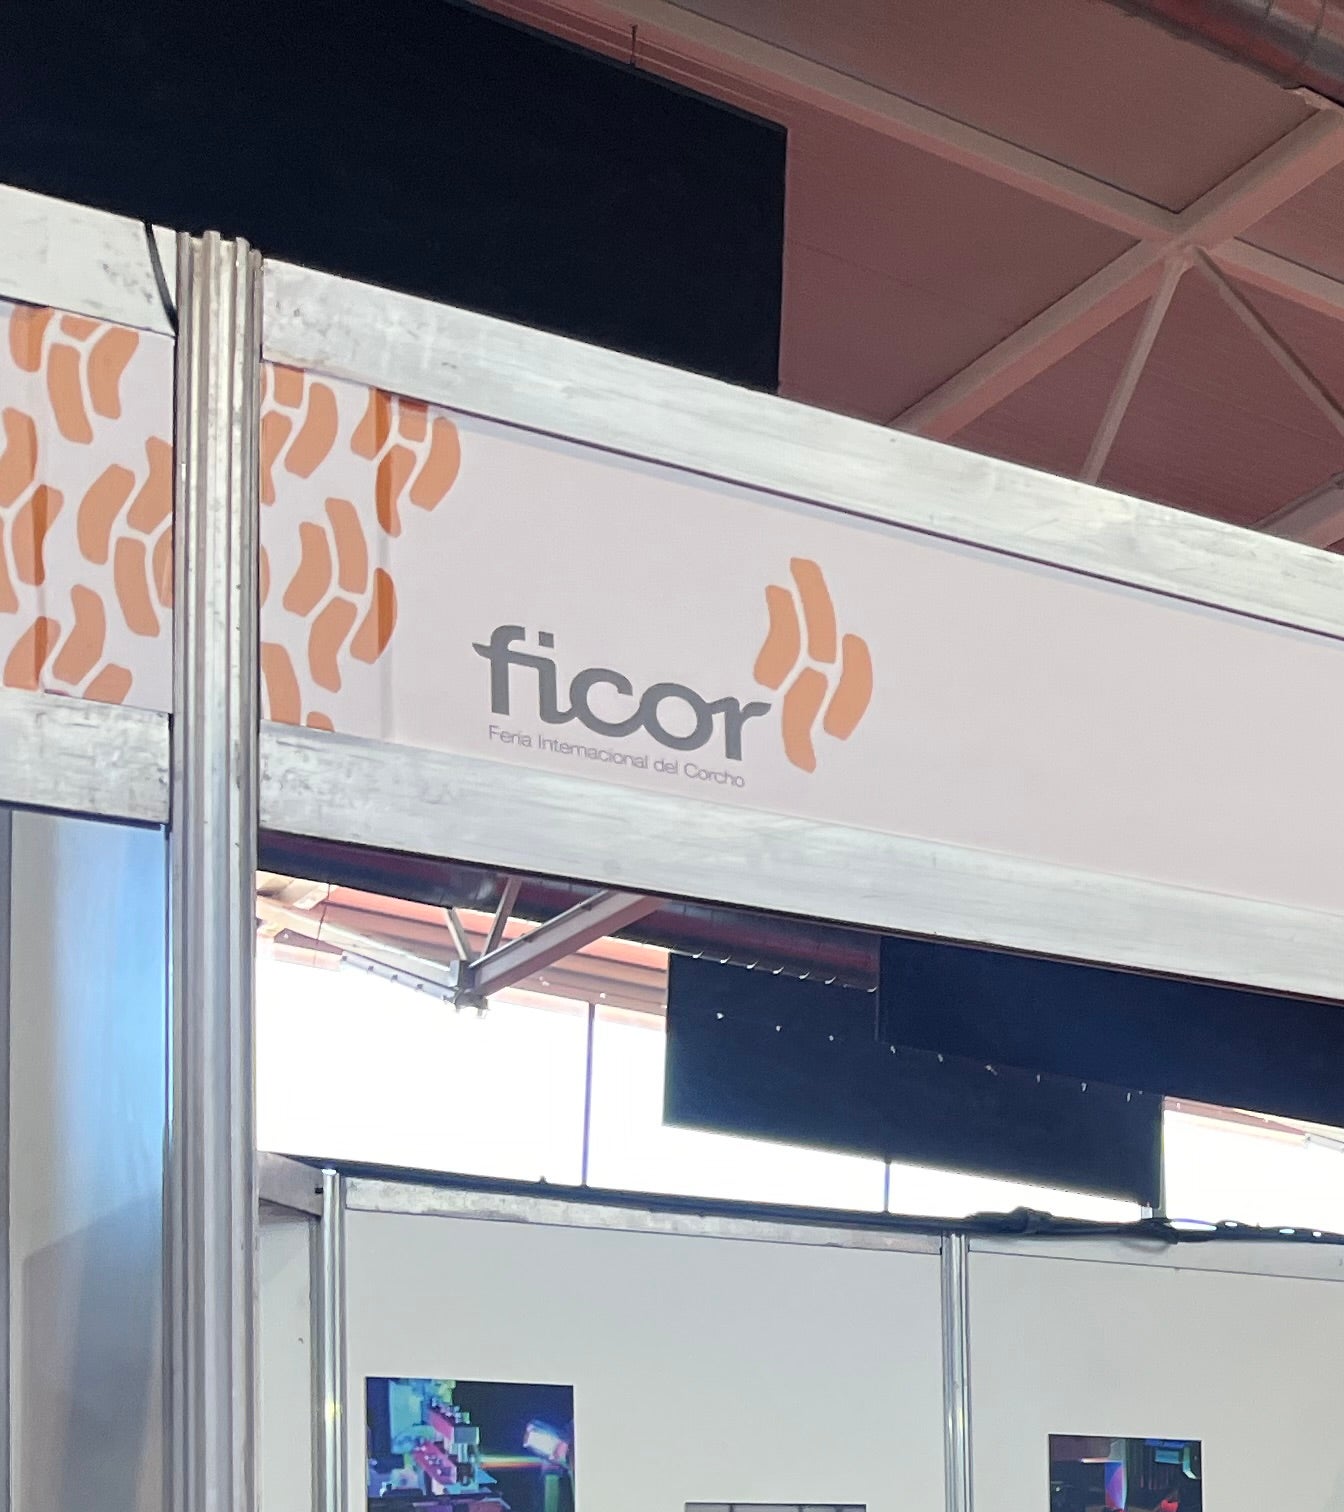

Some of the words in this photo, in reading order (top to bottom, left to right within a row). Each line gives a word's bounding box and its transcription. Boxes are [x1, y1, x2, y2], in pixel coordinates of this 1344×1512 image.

[472, 625, 771, 761] ficor
[488, 724, 532, 748] Feria
[538, 734, 649, 770] Internacional
[653, 757, 679, 775] del
[684, 762, 746, 789] Corcho
